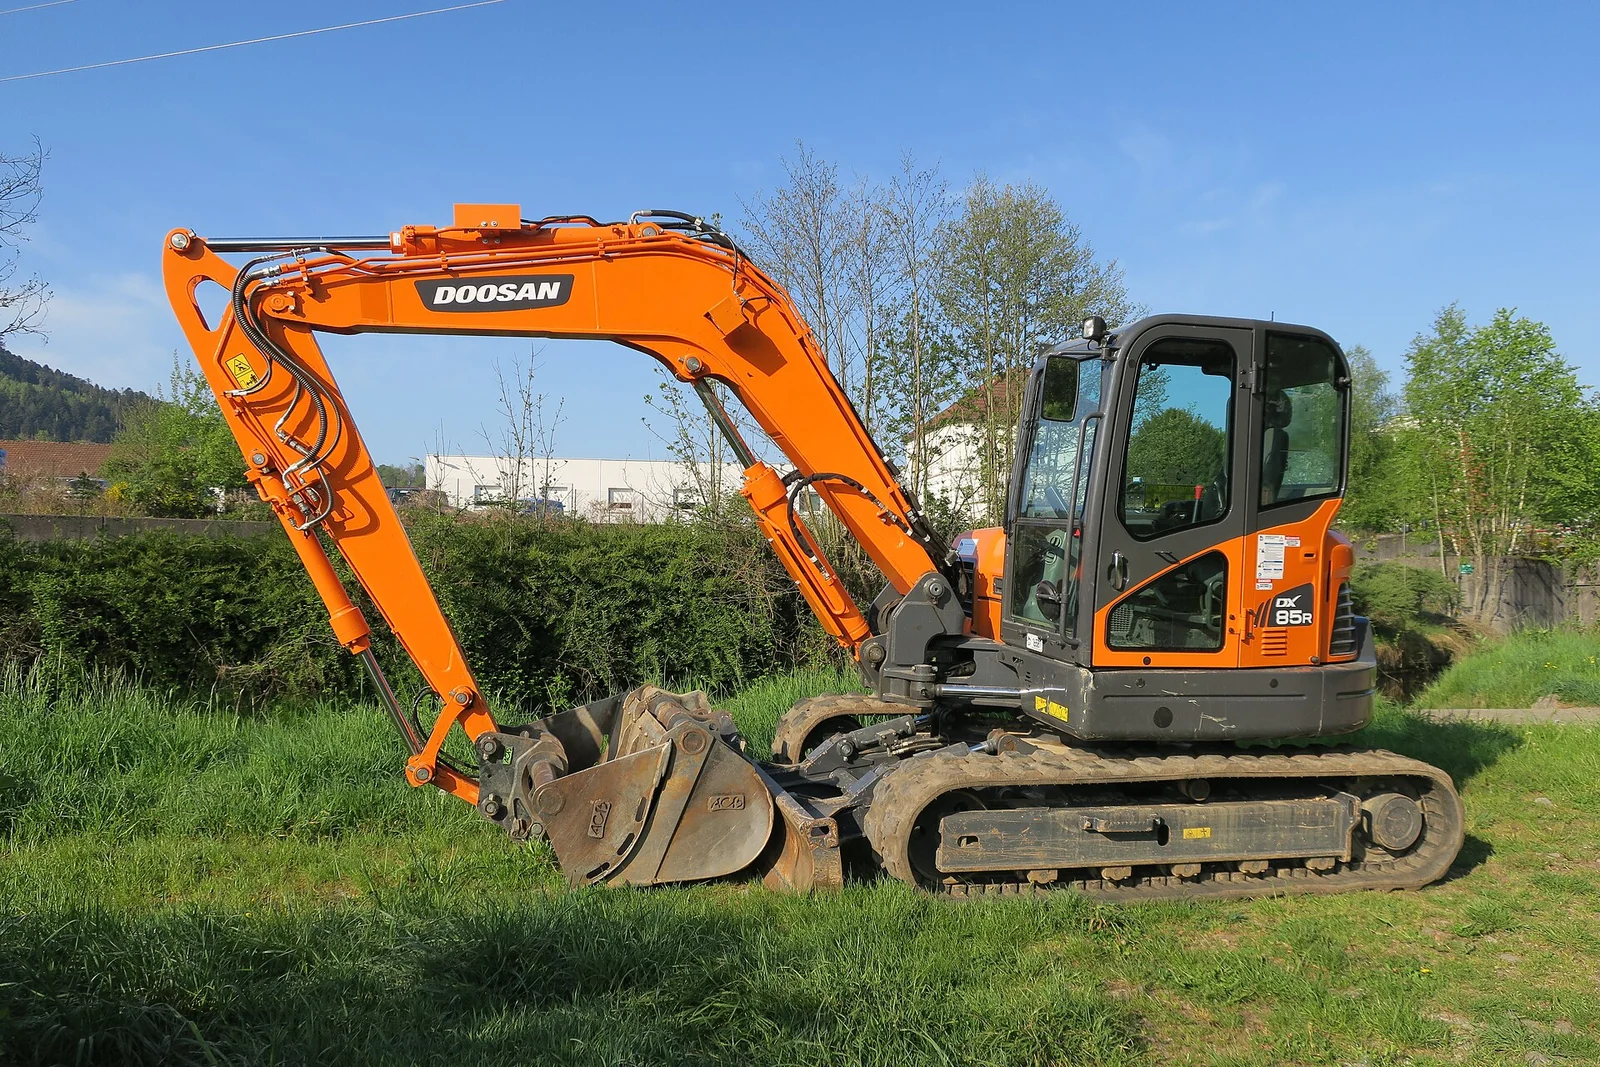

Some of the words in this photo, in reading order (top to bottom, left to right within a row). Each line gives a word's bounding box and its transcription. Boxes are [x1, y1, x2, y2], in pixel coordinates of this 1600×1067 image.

[433, 281, 561, 305] DOOSAN
[1275, 594, 1302, 608] DX
[1276, 609, 1313, 625] 85R
